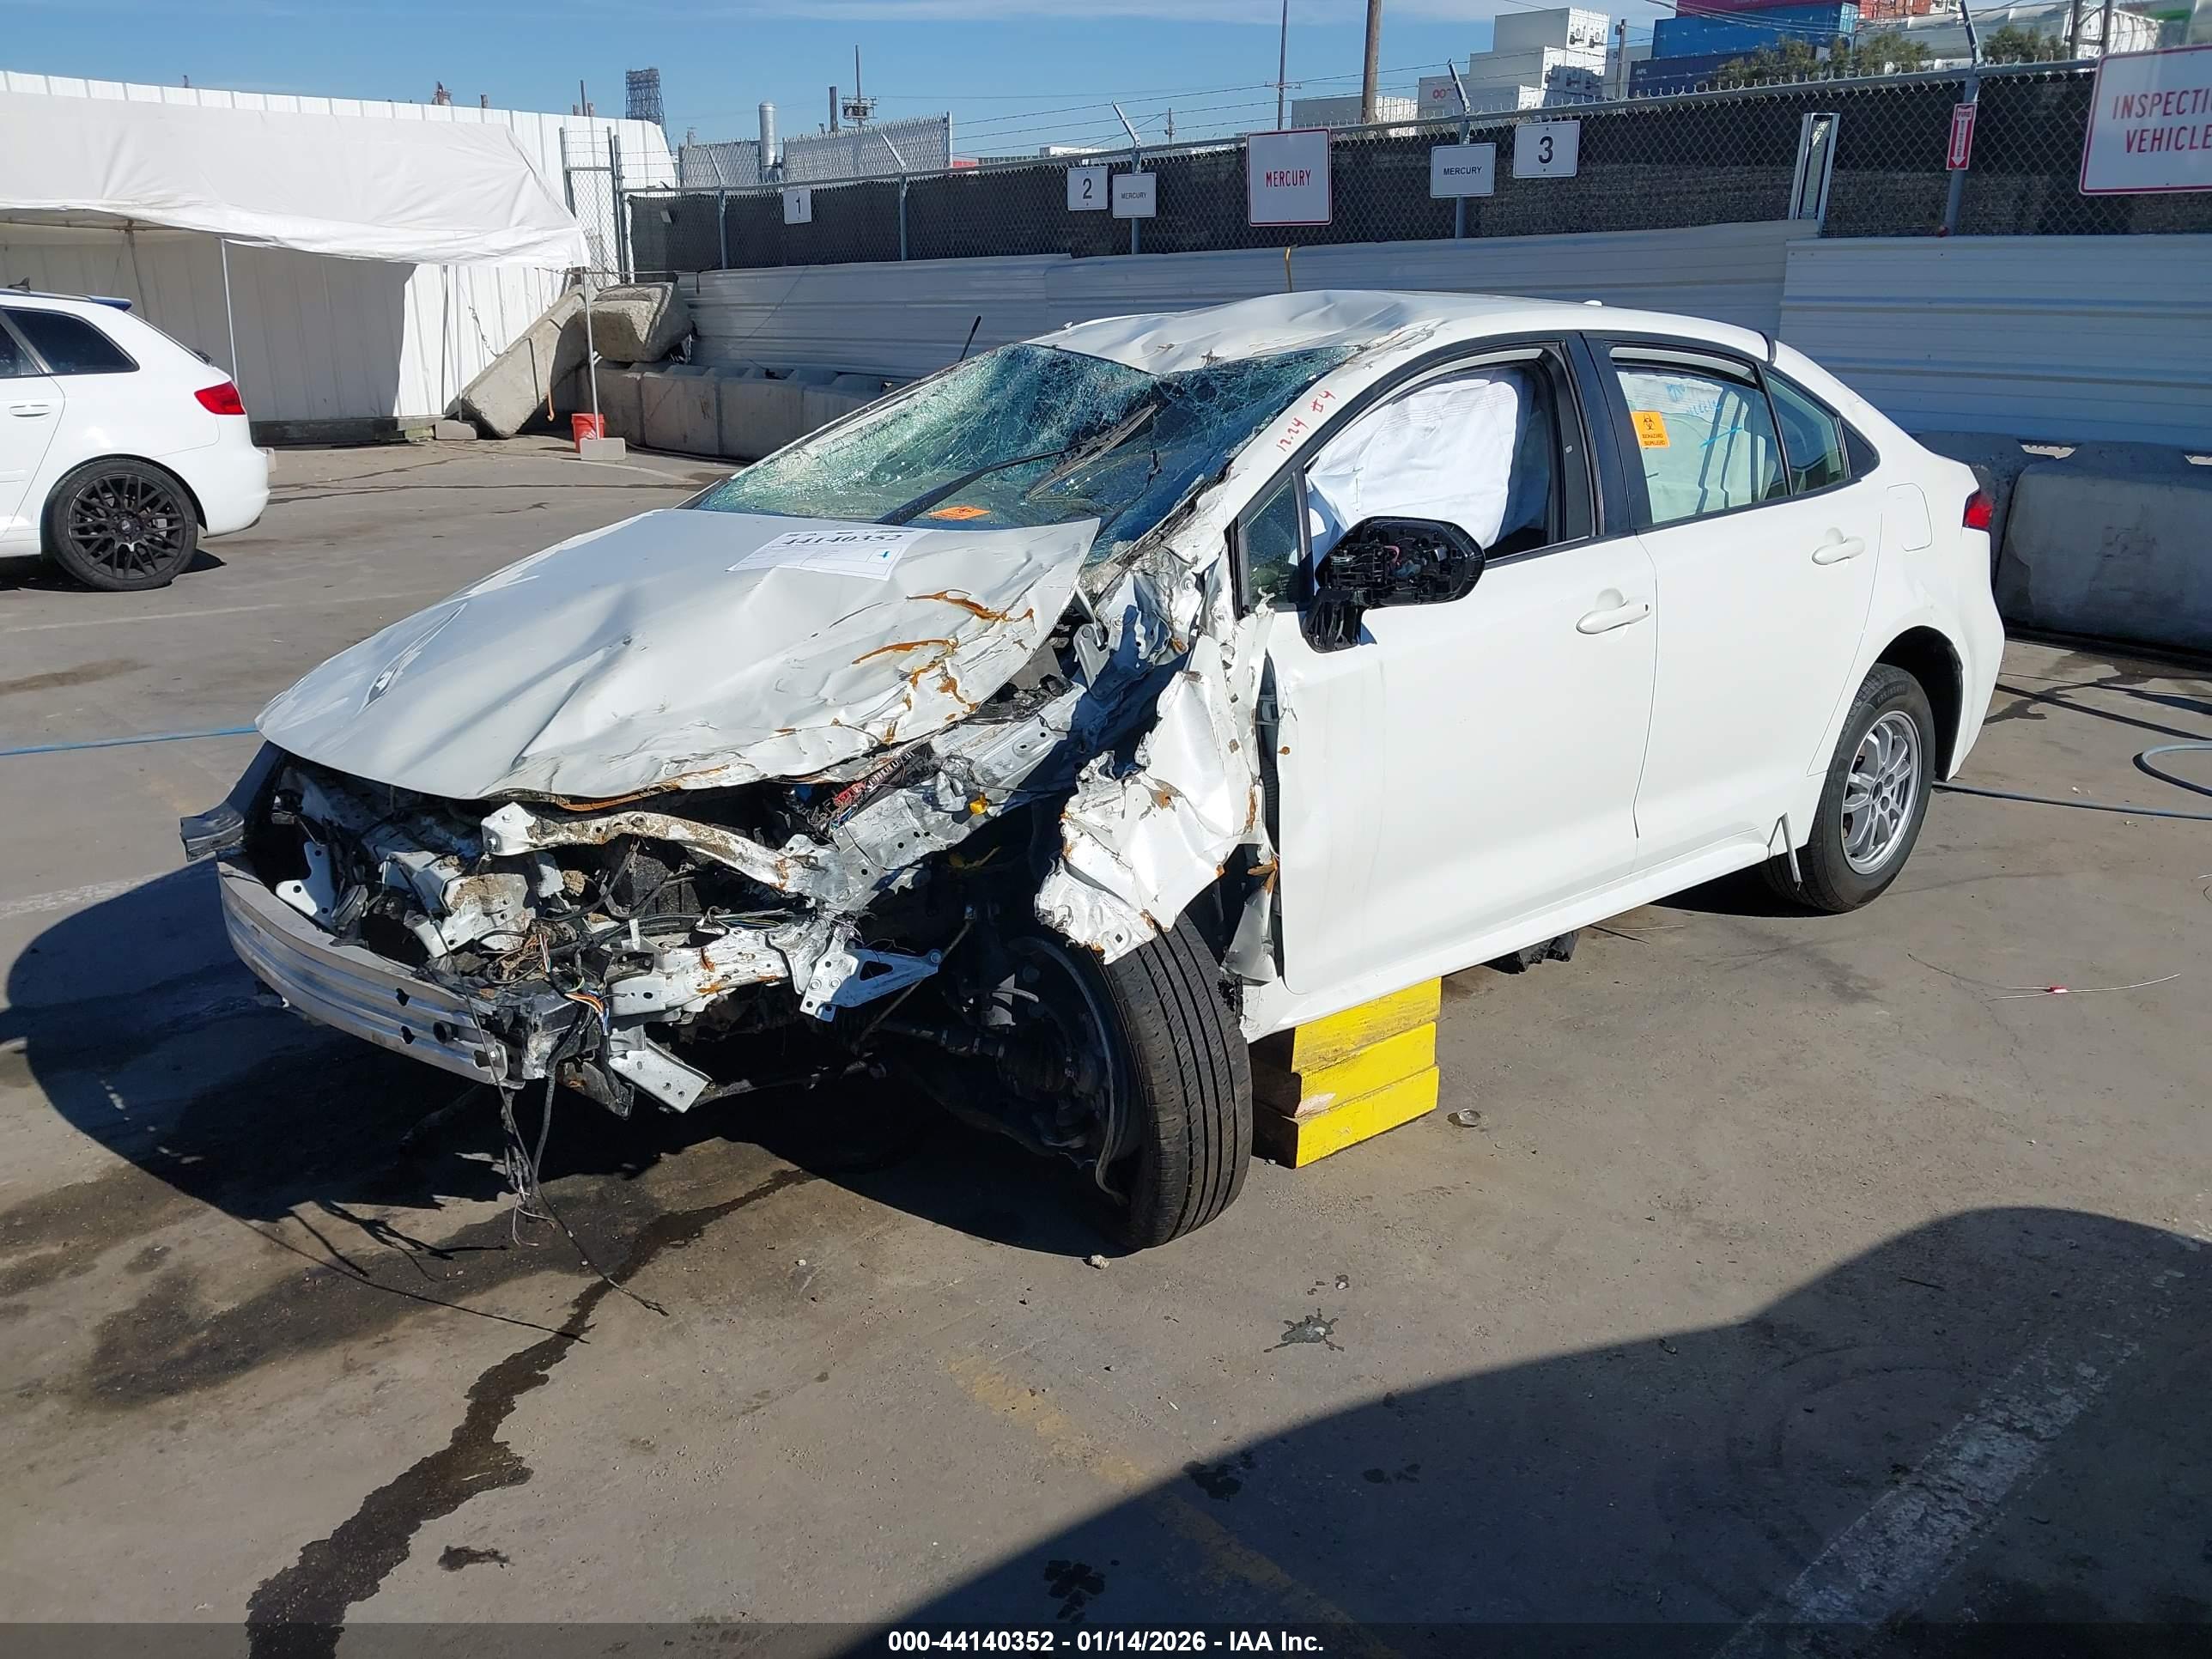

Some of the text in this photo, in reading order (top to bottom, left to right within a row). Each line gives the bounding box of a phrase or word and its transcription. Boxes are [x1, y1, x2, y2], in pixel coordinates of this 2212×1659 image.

[2113, 88, 2212, 120] INSPECTI
[1537, 136, 1554, 164] 3
[1265, 168, 1312, 188] MERCURY
[1443, 165, 1483, 176] MERCURY
[1082, 178, 1094, 200] 2
[1121, 191, 1148, 200] MERCURY
[795, 196, 801, 214] 1
